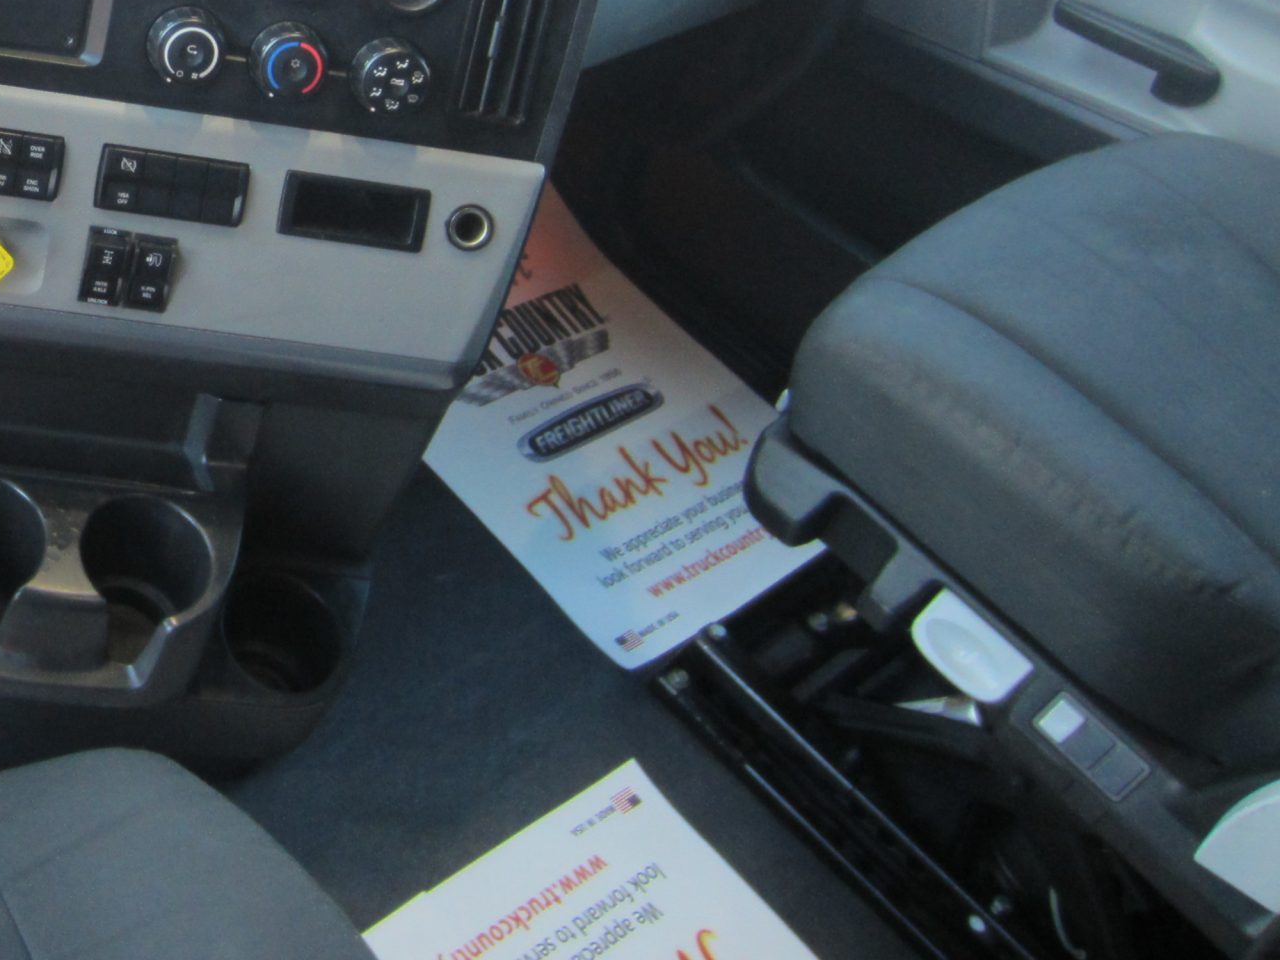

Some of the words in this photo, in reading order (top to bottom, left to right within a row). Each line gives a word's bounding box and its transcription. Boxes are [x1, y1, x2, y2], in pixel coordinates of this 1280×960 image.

[534, 390, 651, 453] FREIGHTLINER
[525, 445, 667, 541] Thank
[653, 403, 748, 487] You!
[600, 545, 624, 562] We
[622, 515, 683, 552] appreciate
[681, 500, 707, 523] your
[596, 567, 628, 589] look
[623, 544, 672, 574] forward
[670, 537, 686, 551] to
[627, 862, 668, 894] look
[555, 924, 577, 945] to
[571, 885, 634, 935] forward
[632, 902, 665, 926] We
